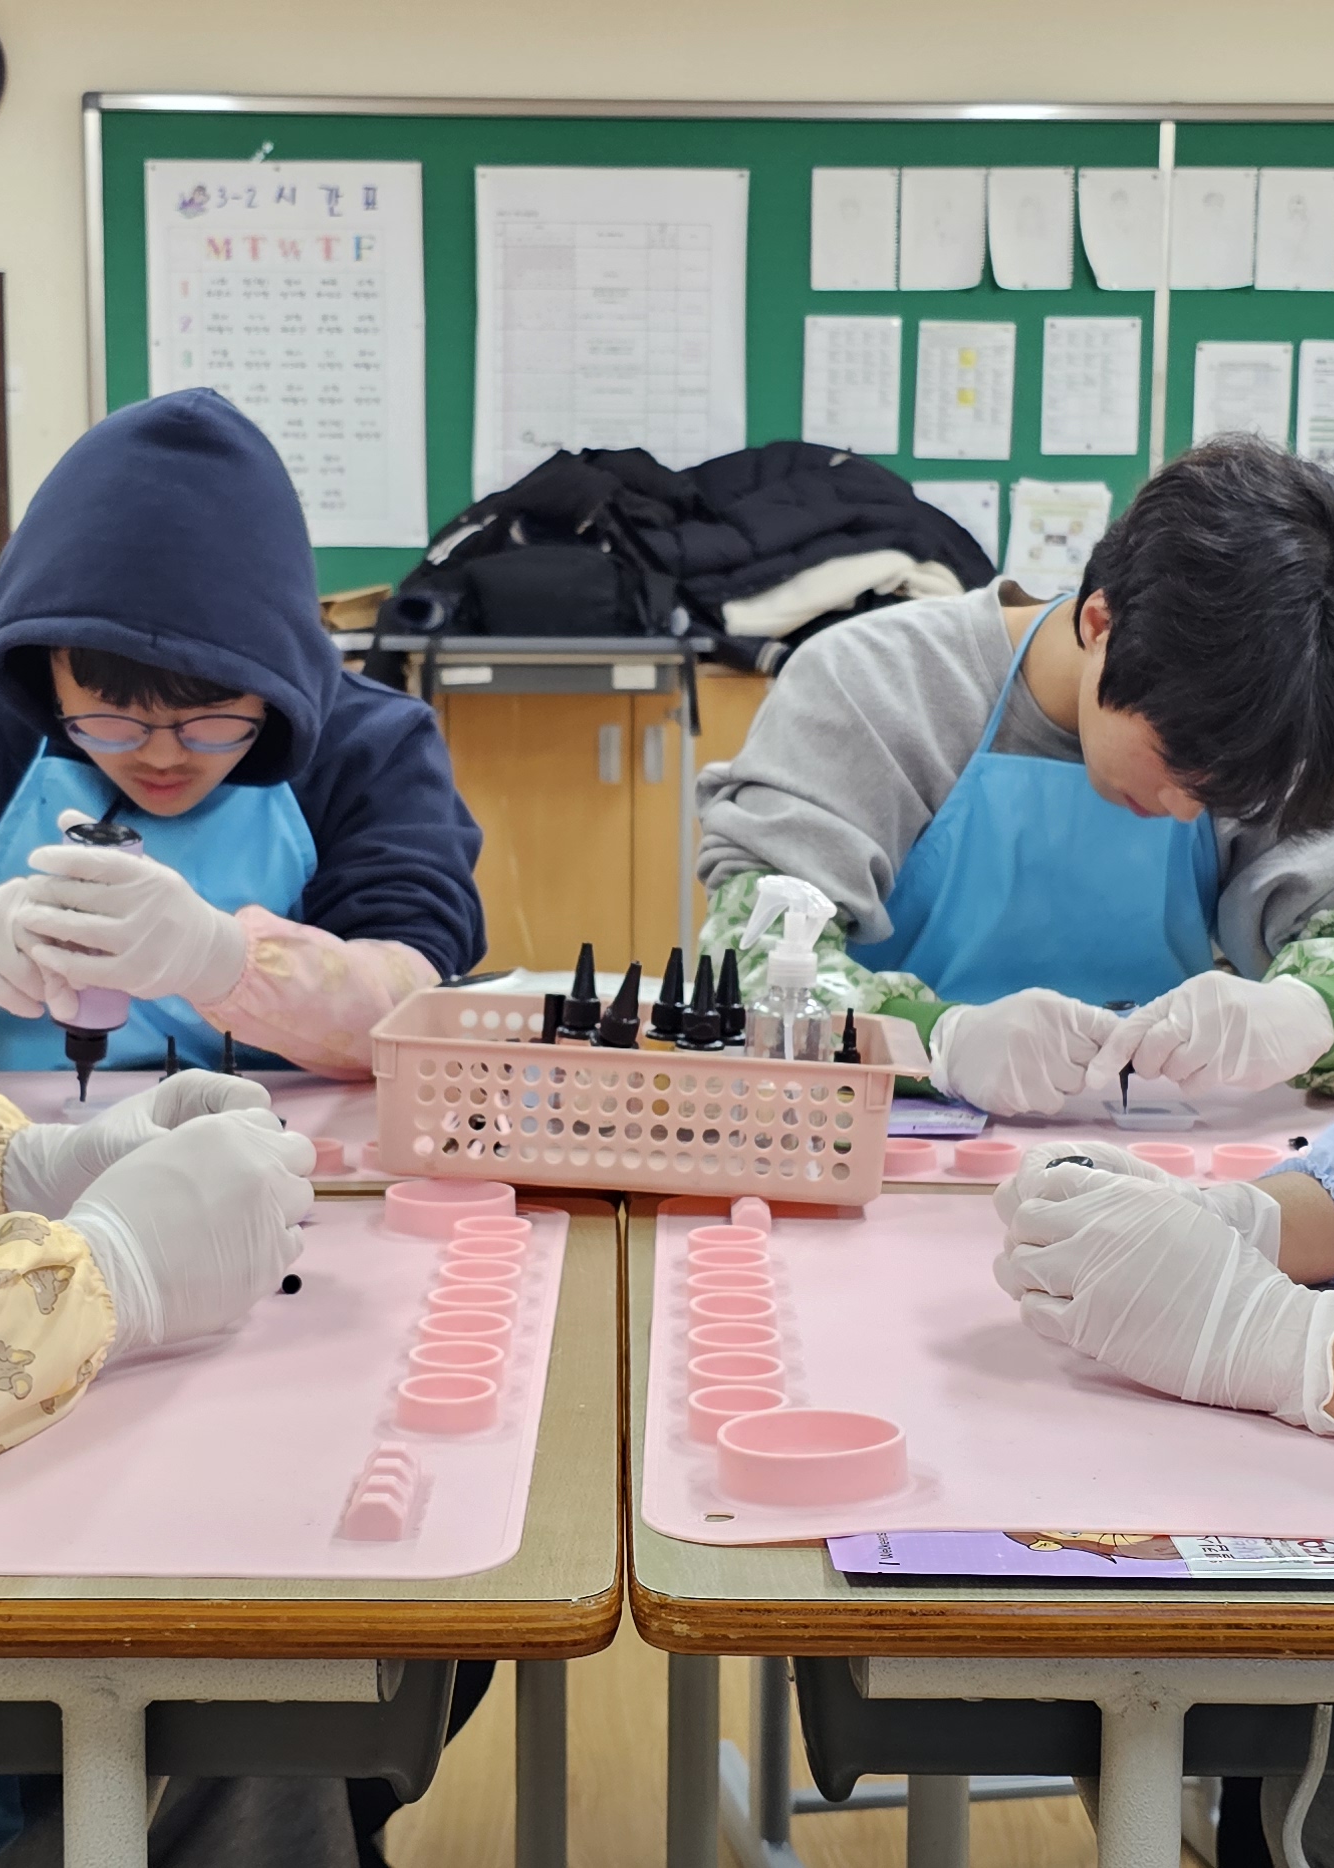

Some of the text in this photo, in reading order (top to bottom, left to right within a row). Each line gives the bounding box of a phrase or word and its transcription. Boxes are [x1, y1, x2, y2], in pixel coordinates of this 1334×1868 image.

[216, 184, 379, 217] 3-2 시 간 표
[207, 235, 376, 262] M T W T F
